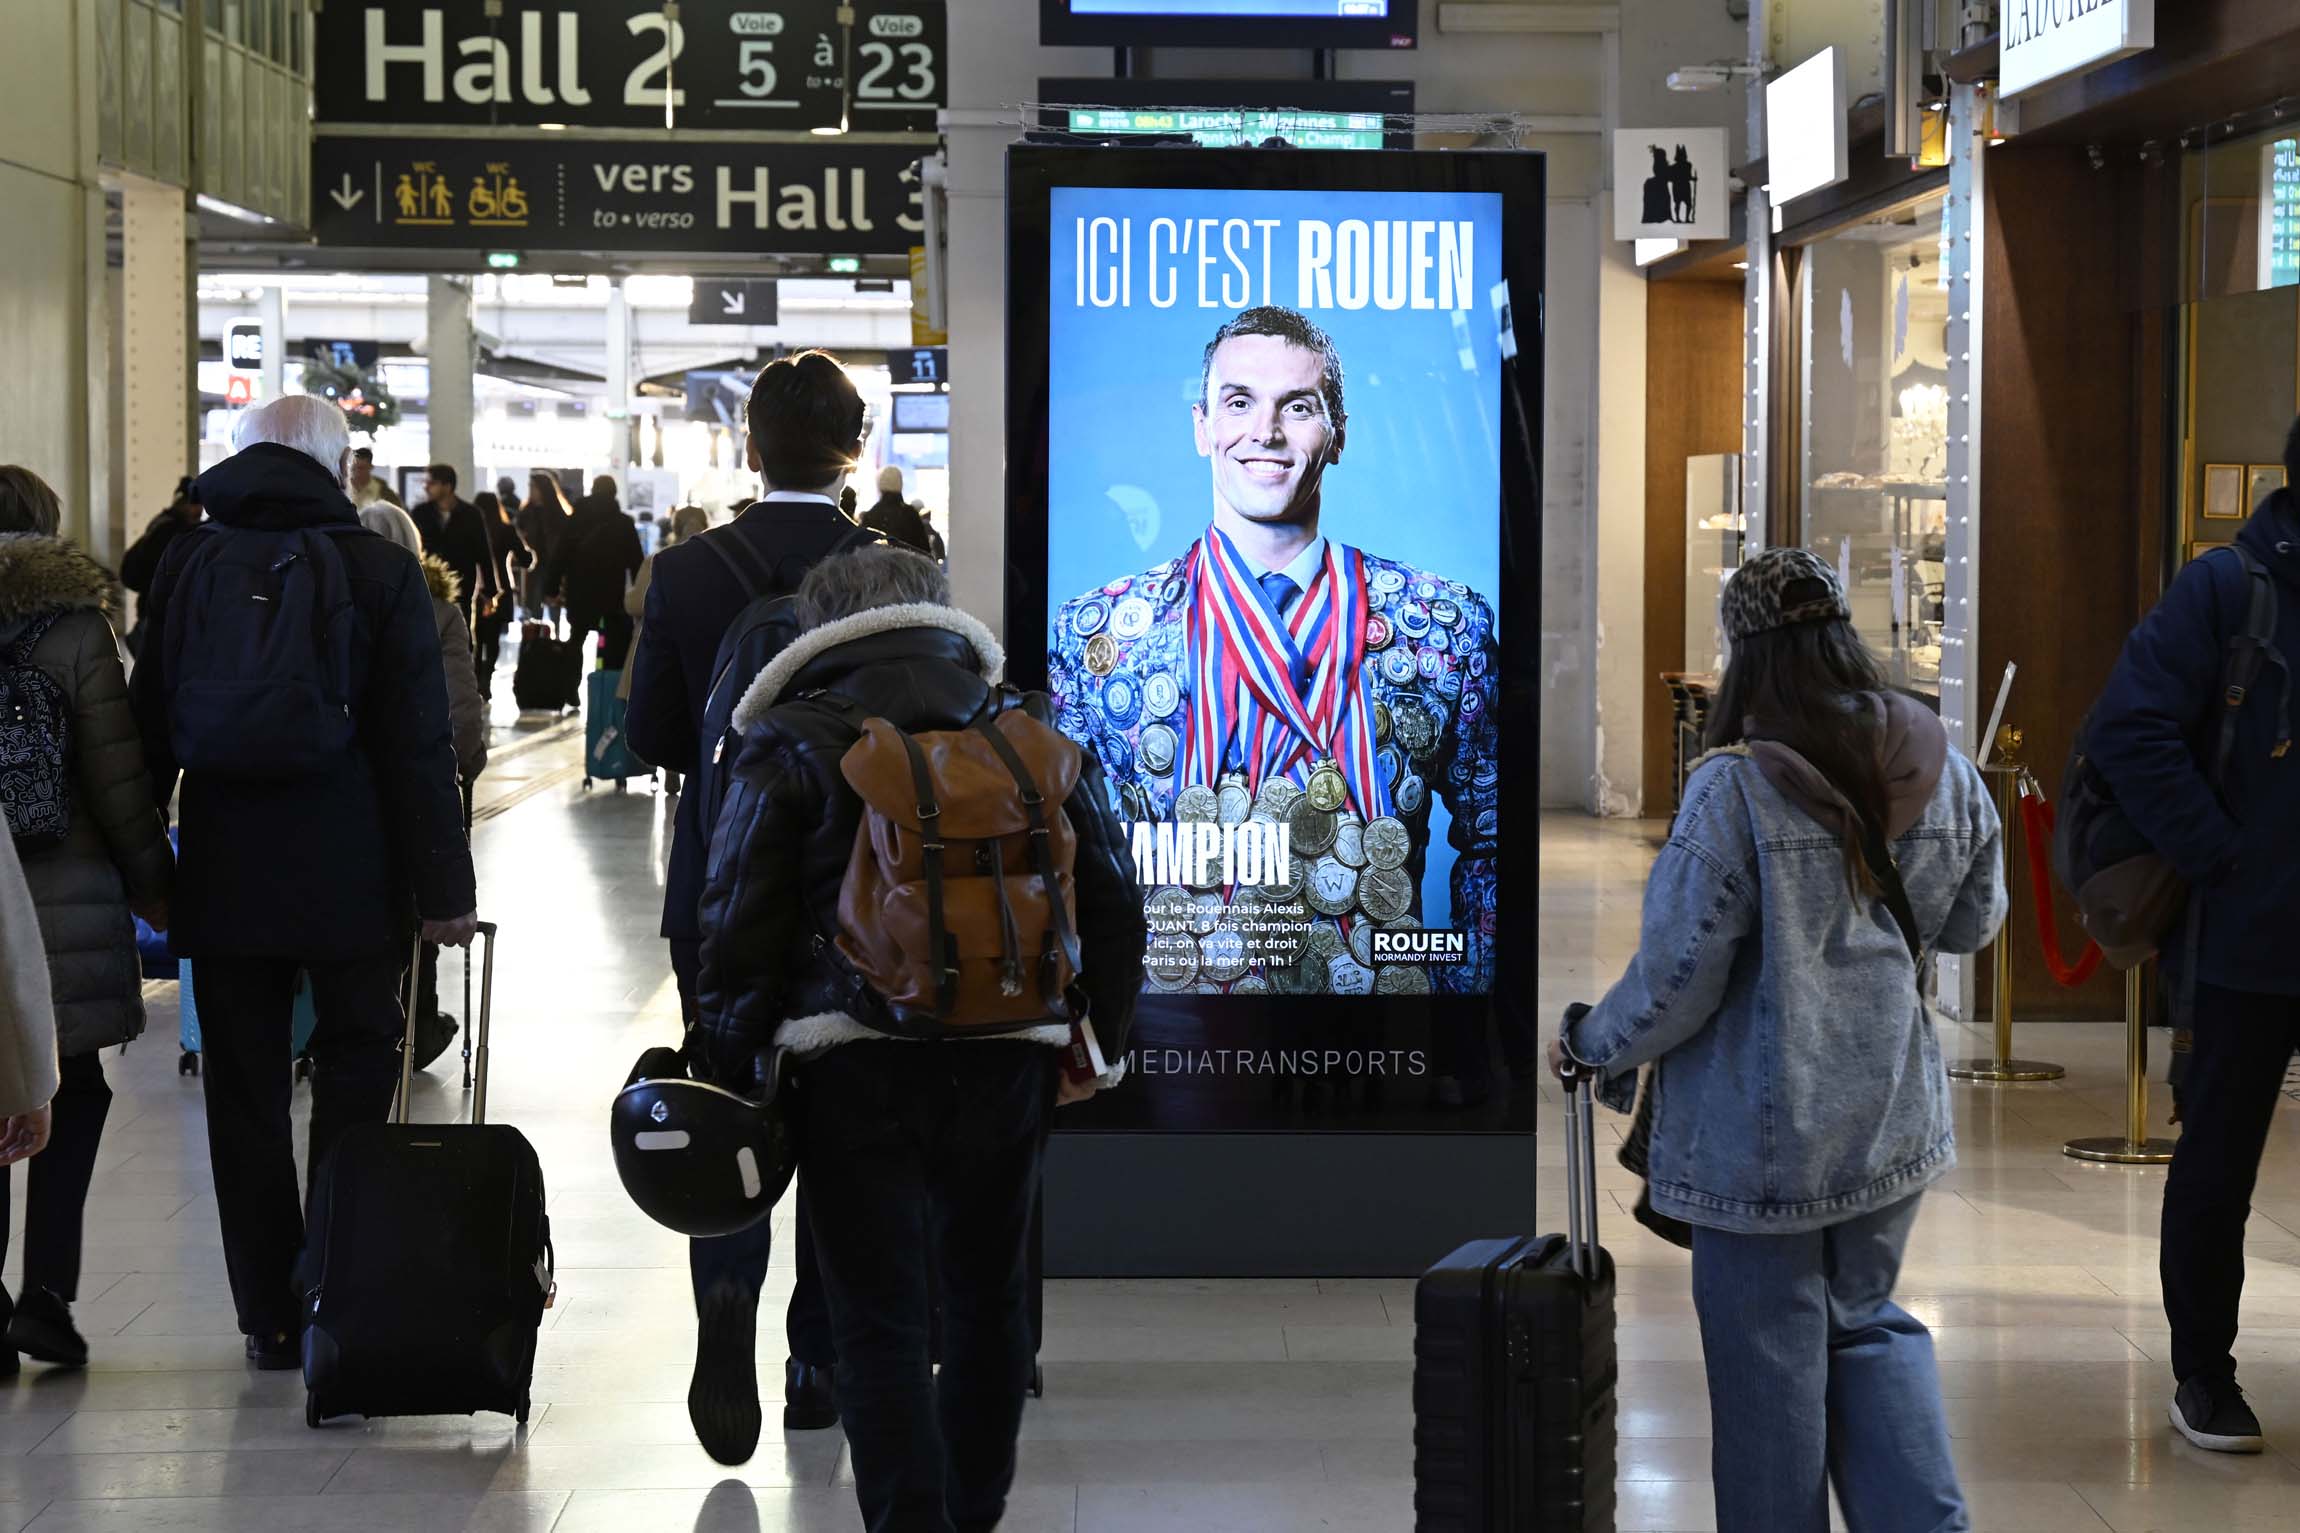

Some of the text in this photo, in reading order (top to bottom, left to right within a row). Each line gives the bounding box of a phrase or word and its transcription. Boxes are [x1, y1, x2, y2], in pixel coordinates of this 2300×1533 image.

[737, 16, 776, 31] Voie
[876, 19, 915, 33] Voie
[365, 8, 685, 106] Hall 2
[739, 33, 936, 99] 5 à 23
[593, 163, 694, 192] vers
[716, 166, 873, 231] Hall
[636, 211, 694, 229] verso
[1076, 216, 1474, 310] ICI C'EST ROUEN
[1120, 821, 1290, 886] AMPION
[1143, 902, 1304, 915] our le Rouennais Alexis
[1147, 919, 1312, 935] QUANT, 8 fois champion
[1154, 937, 1173, 950] ici,
[1176, 940, 1193, 949] on
[1198, 940, 1213, 949] va
[1217, 937, 1243, 949] vite
[1247, 938, 1260, 949] et
[1264, 937, 1298, 949] droit
[1374, 933, 1463, 952] ROUEN
[1142, 954, 1175, 967] Paris
[1179, 957, 1197, 967] ou
[1201, 954, 1213, 967] la
[1217, 957, 1245, 967] mer
[1249, 957, 1266, 967] en
[1270, 955, 1285, 967] 1h
[1374, 953, 1463, 962] NORMANDY INVEST
